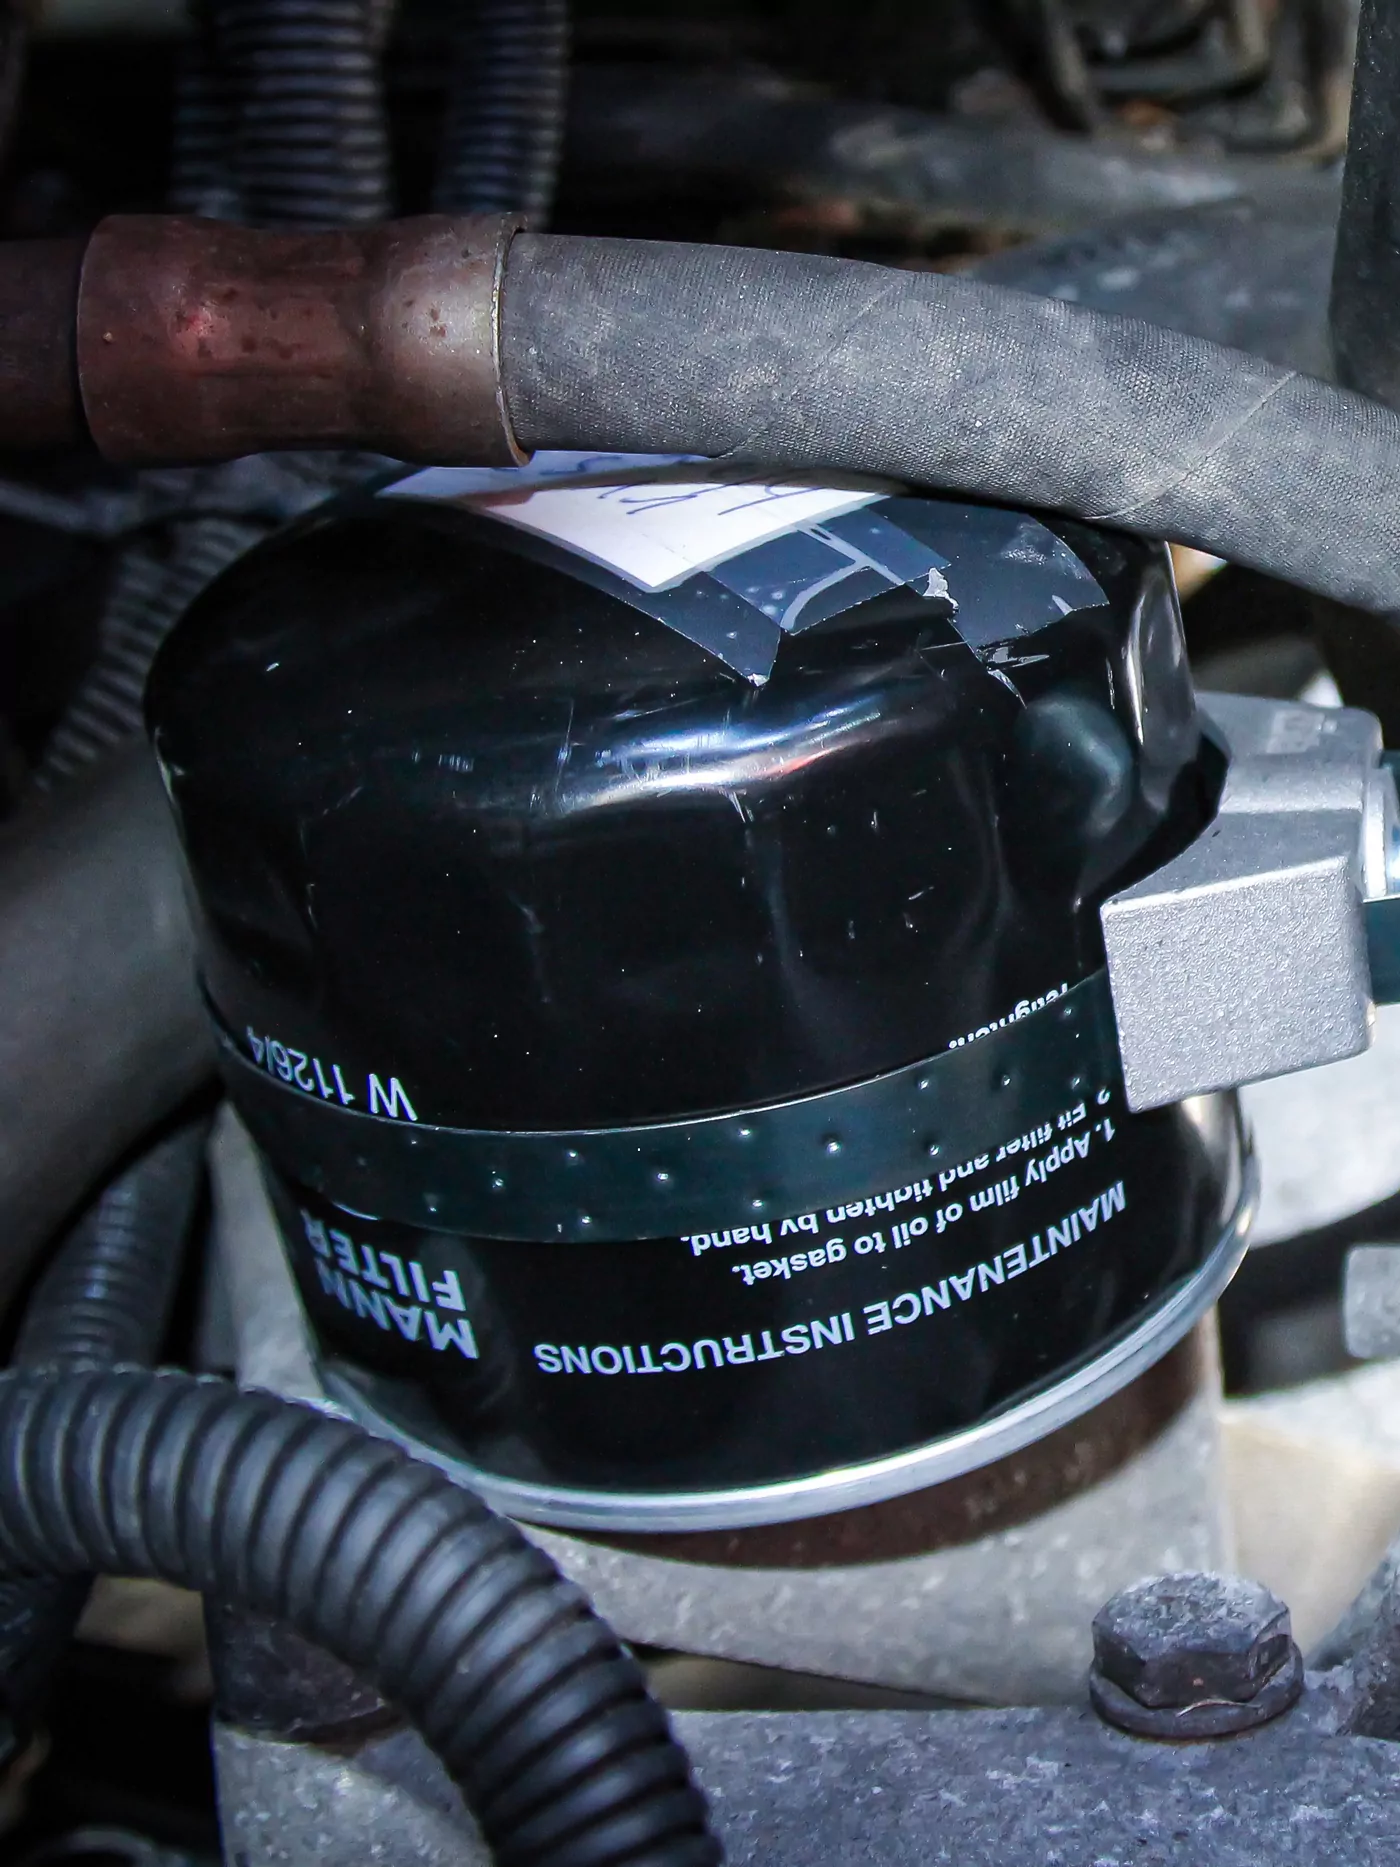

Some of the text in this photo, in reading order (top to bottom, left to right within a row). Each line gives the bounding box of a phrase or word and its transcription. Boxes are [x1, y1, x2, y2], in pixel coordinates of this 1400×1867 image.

[246, 1026, 418, 1121] W 1126/4
[996, 1120, 1052, 1162] filter
[1057, 1102, 1086, 1131] Fit
[732, 1118, 1115, 1285] 1. Apply film of oil to gasket.
[826, 1177, 931, 1223] tighten
[940, 1154, 989, 1189] and
[300, 1209, 466, 1311] FILTER
[680, 1223, 772, 1255] hand.
[315, 1259, 479, 1358] MANN
[533, 1180, 1125, 1374] MAINTENANCE INSTRUCTIONS
